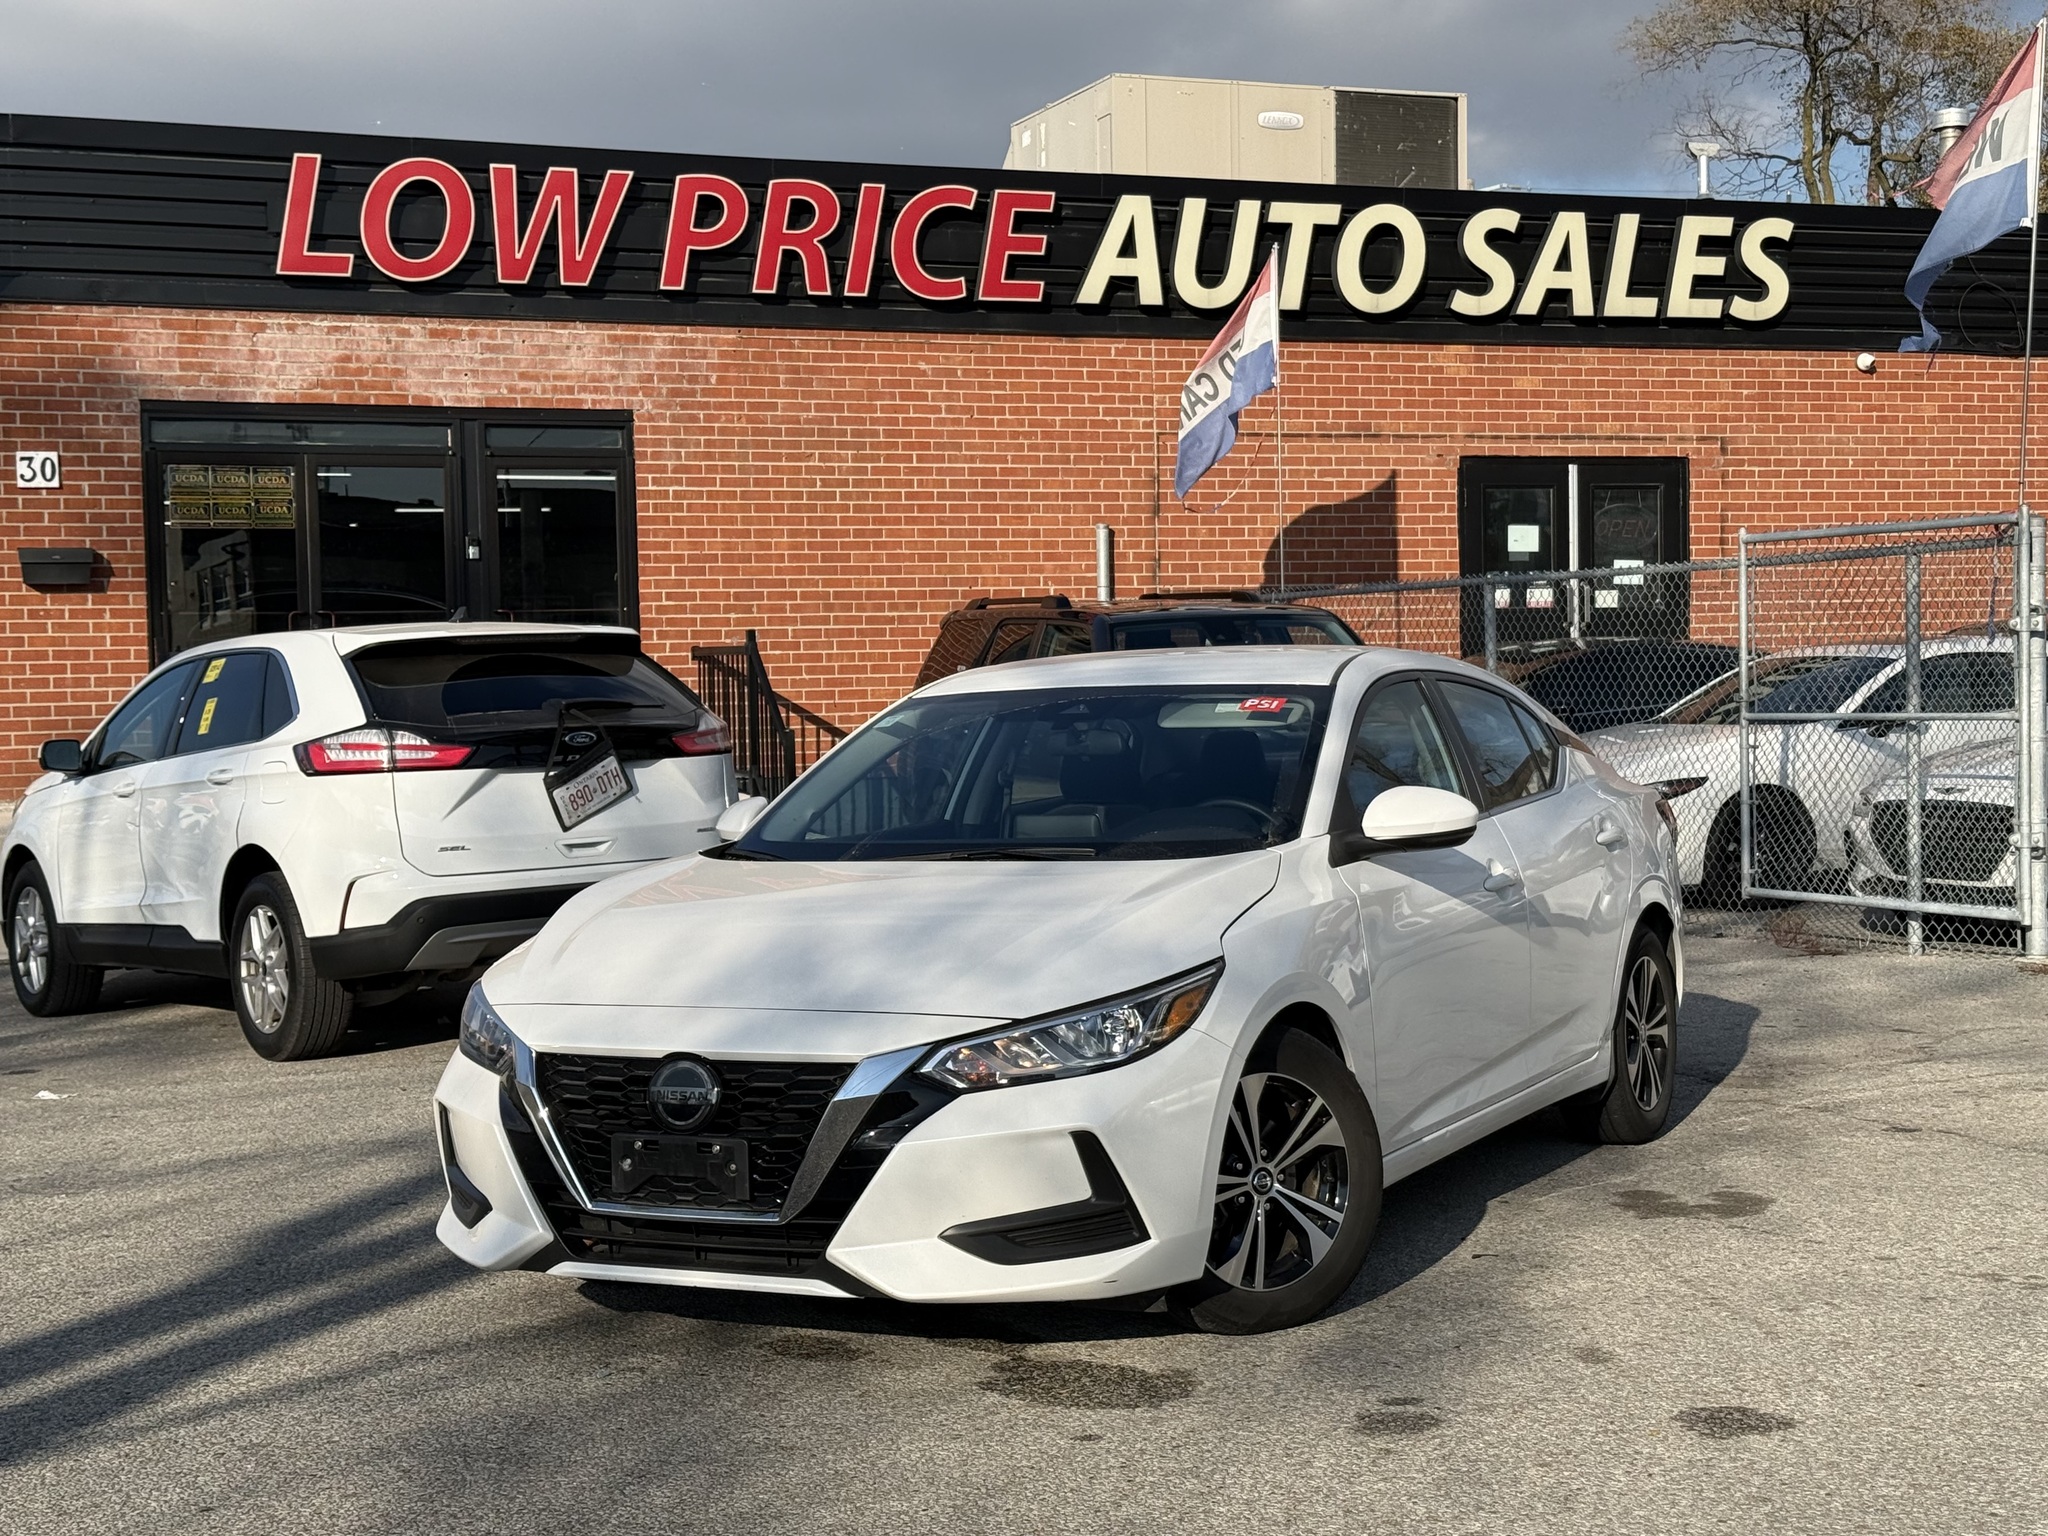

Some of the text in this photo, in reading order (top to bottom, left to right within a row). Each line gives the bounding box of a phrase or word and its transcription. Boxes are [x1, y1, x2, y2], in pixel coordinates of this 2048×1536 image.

[275, 152, 1795, 322] LOW PRICE AUTO SALES
[19, 456, 57, 483] 30
[175, 474, 205, 483] UCDA
[216, 475, 246, 484] UCDA
[258, 476, 287, 484] UCDA
[177, 507, 205, 515] UCDA
[218, 507, 247, 515] UCDA
[260, 506, 289, 514] UCDA
[1595, 519, 1651, 538] OPEN
[1244, 698, 1279, 709] PSI
[596, 766, 622, 795] DTH
[437, 845, 471, 853] SEL
[656, 1089, 708, 1102] NISSAN
